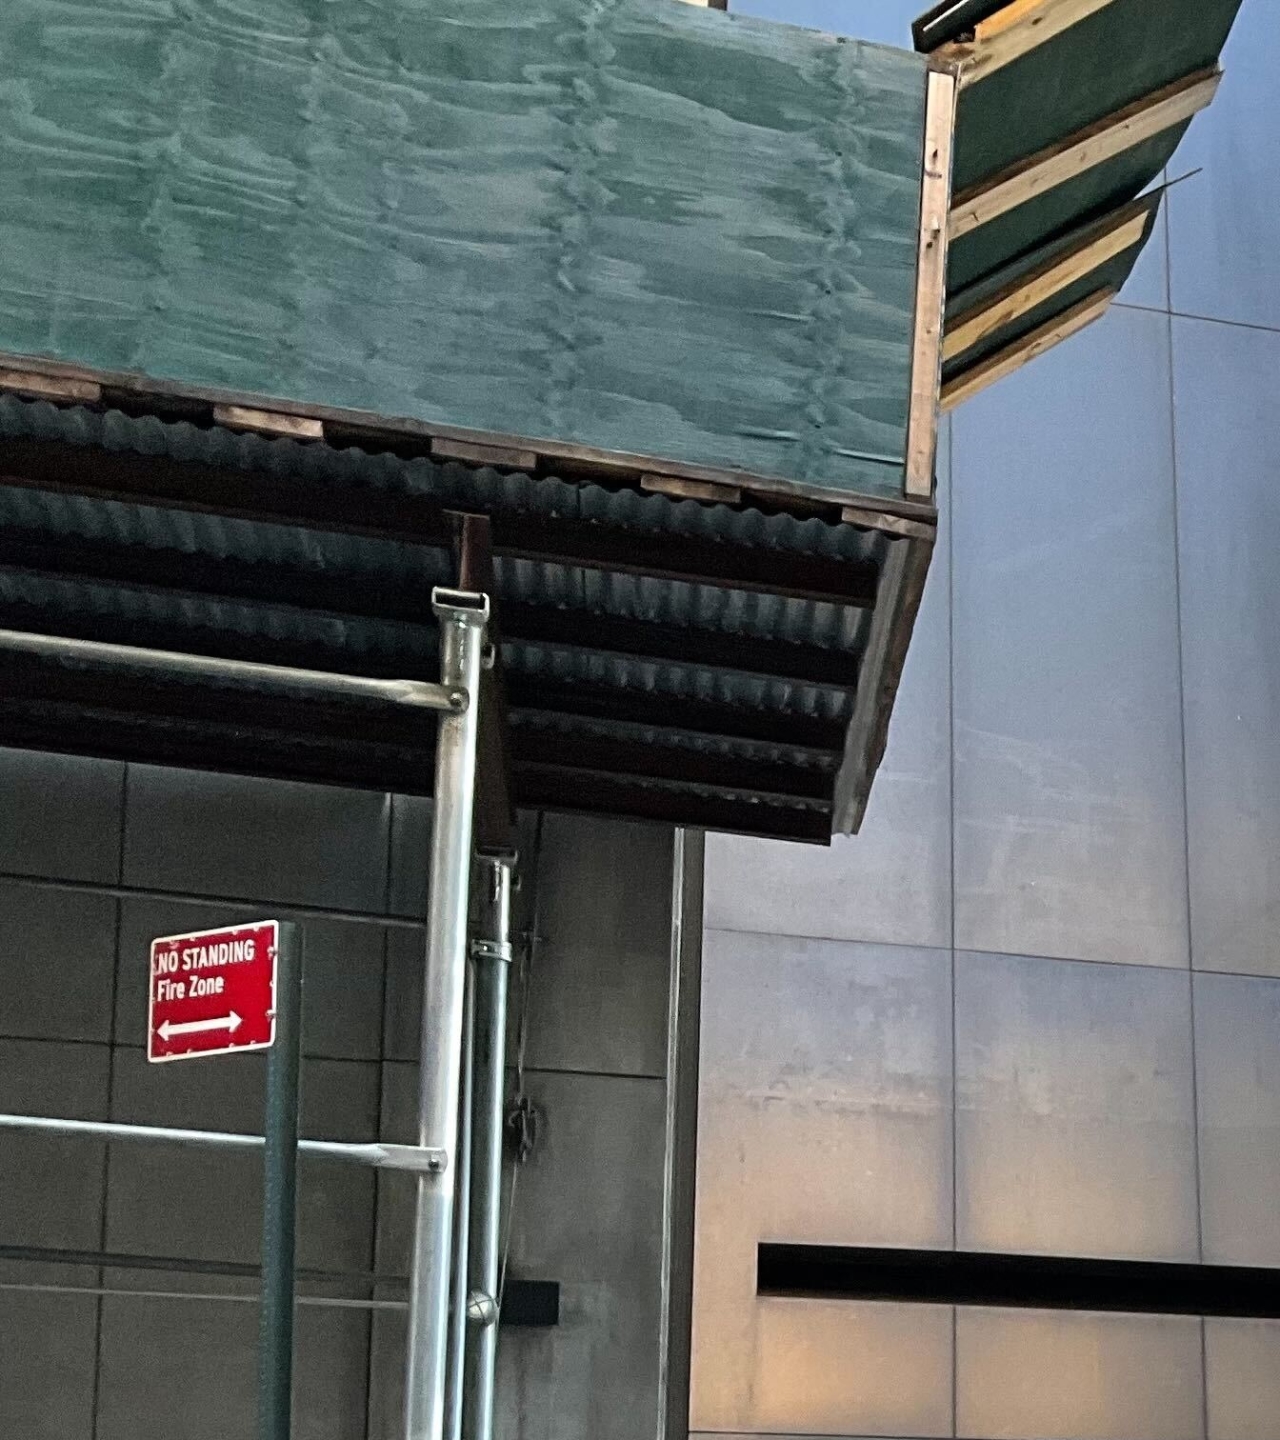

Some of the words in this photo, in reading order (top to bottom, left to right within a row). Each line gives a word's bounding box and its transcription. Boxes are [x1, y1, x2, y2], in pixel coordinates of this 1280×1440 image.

[157, 950, 179, 974] NO
[182, 939, 255, 971] STANDING
[157, 978, 186, 1002] Fire
[189, 975, 225, 998] Zone
